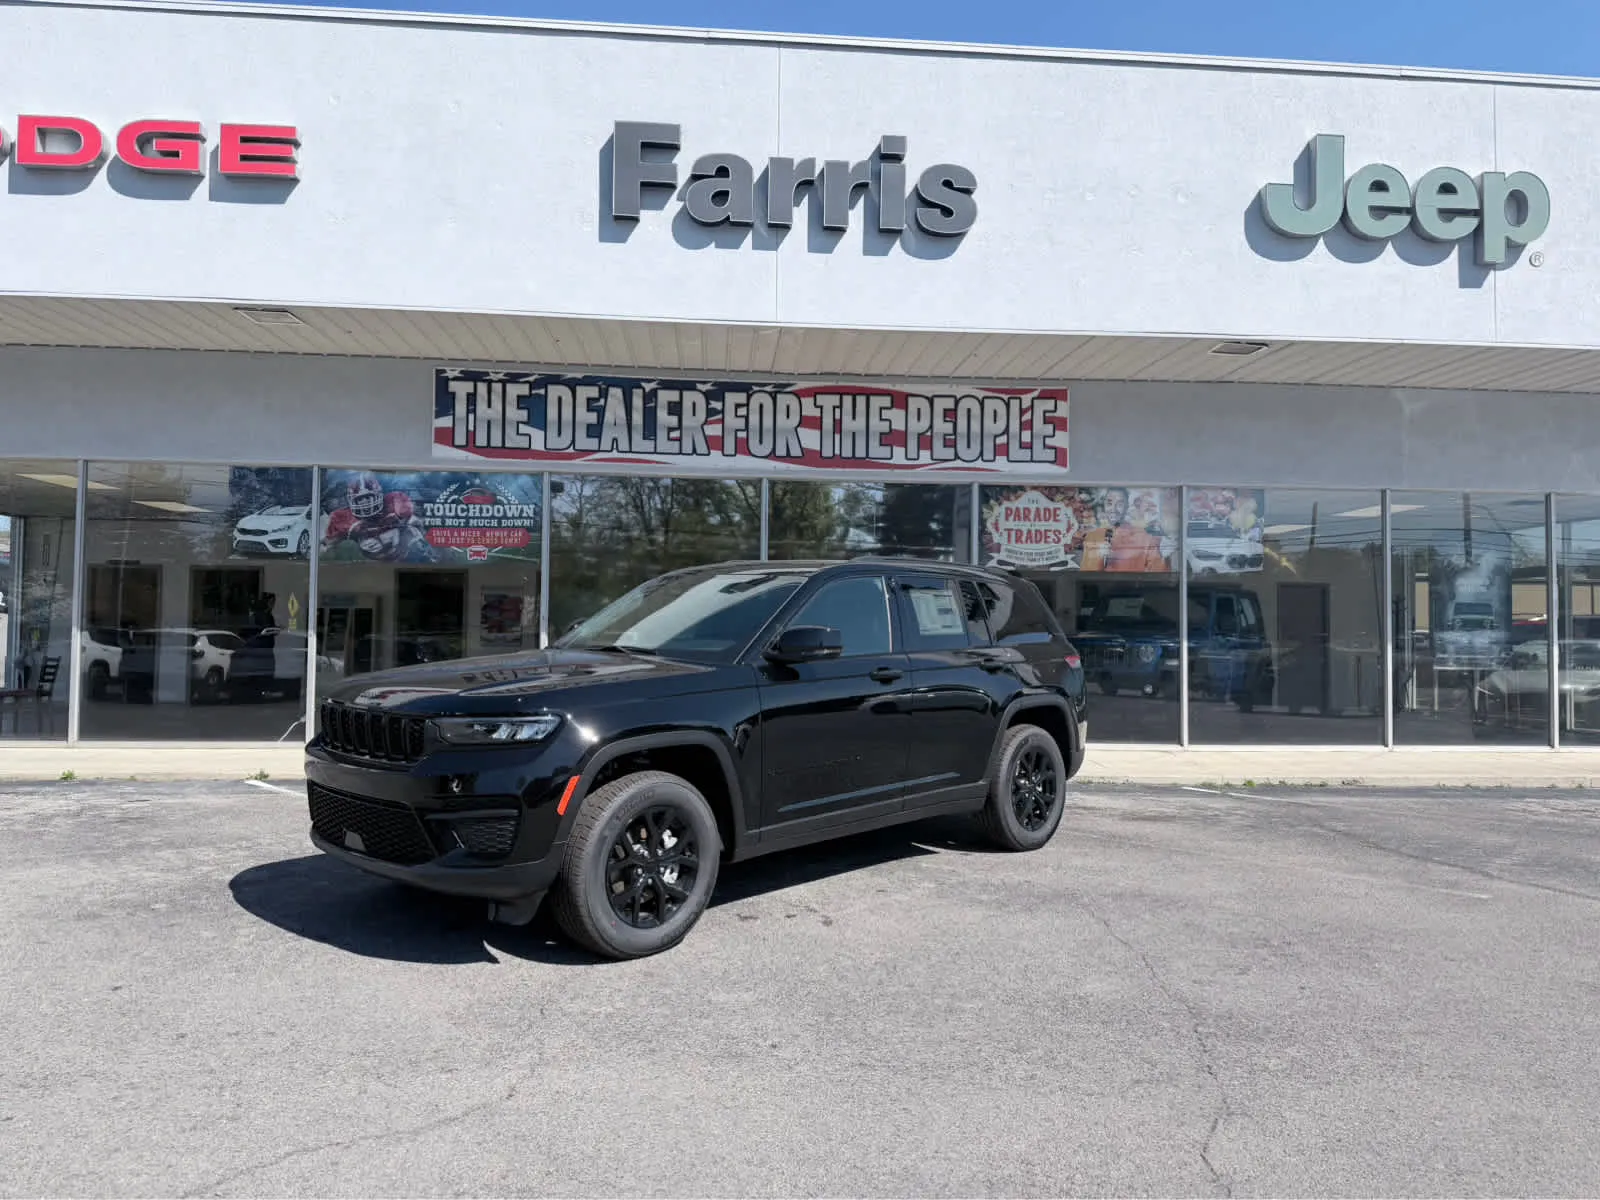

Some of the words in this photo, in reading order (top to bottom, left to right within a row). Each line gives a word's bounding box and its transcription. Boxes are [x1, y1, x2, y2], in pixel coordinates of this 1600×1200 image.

[0, 114, 300, 180] DGE
[613, 120, 978, 236] Farris
[1262, 134, 1550, 265] Jeep
[448, 381, 531, 449] THE
[545, 384, 710, 456] DEALER
[722, 389, 803, 458] FOR
[815, 394, 893, 459] THE
[906, 394, 1058, 462] PEOPLE
[424, 503, 535, 518] TOUCHDOWN
[425, 518, 442, 526] FOR
[445, 518, 466, 526] NOT
[470, 519, 498, 527] MUCH
[502, 519, 534, 527] DOWN!
[1004, 507, 1062, 522] PARADE
[1004, 528, 1062, 544] TRADES
